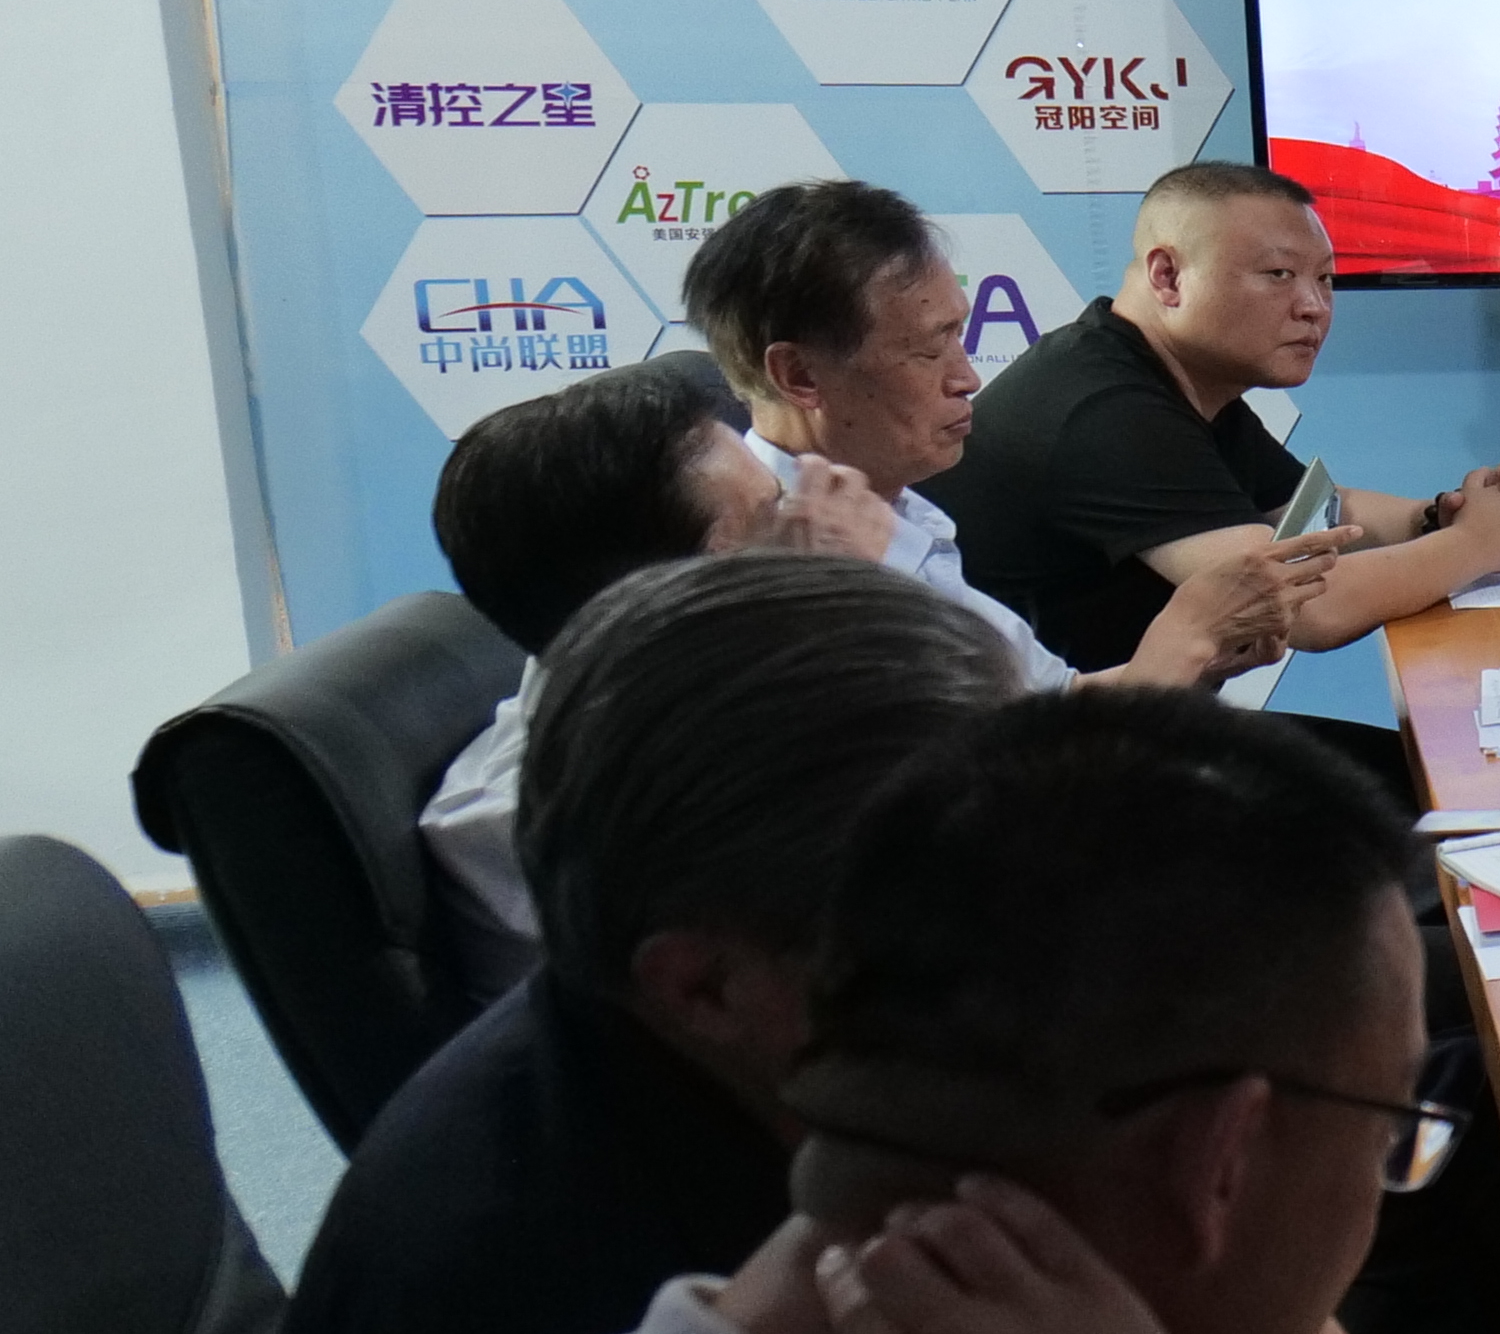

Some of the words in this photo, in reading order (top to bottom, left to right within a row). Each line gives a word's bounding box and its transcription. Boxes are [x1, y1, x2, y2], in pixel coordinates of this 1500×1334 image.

[370, 81, 597, 128] 清控之星
[1034, 106, 1160, 131] 冠阳空间
[419, 334, 612, 374] 中尚联盟
